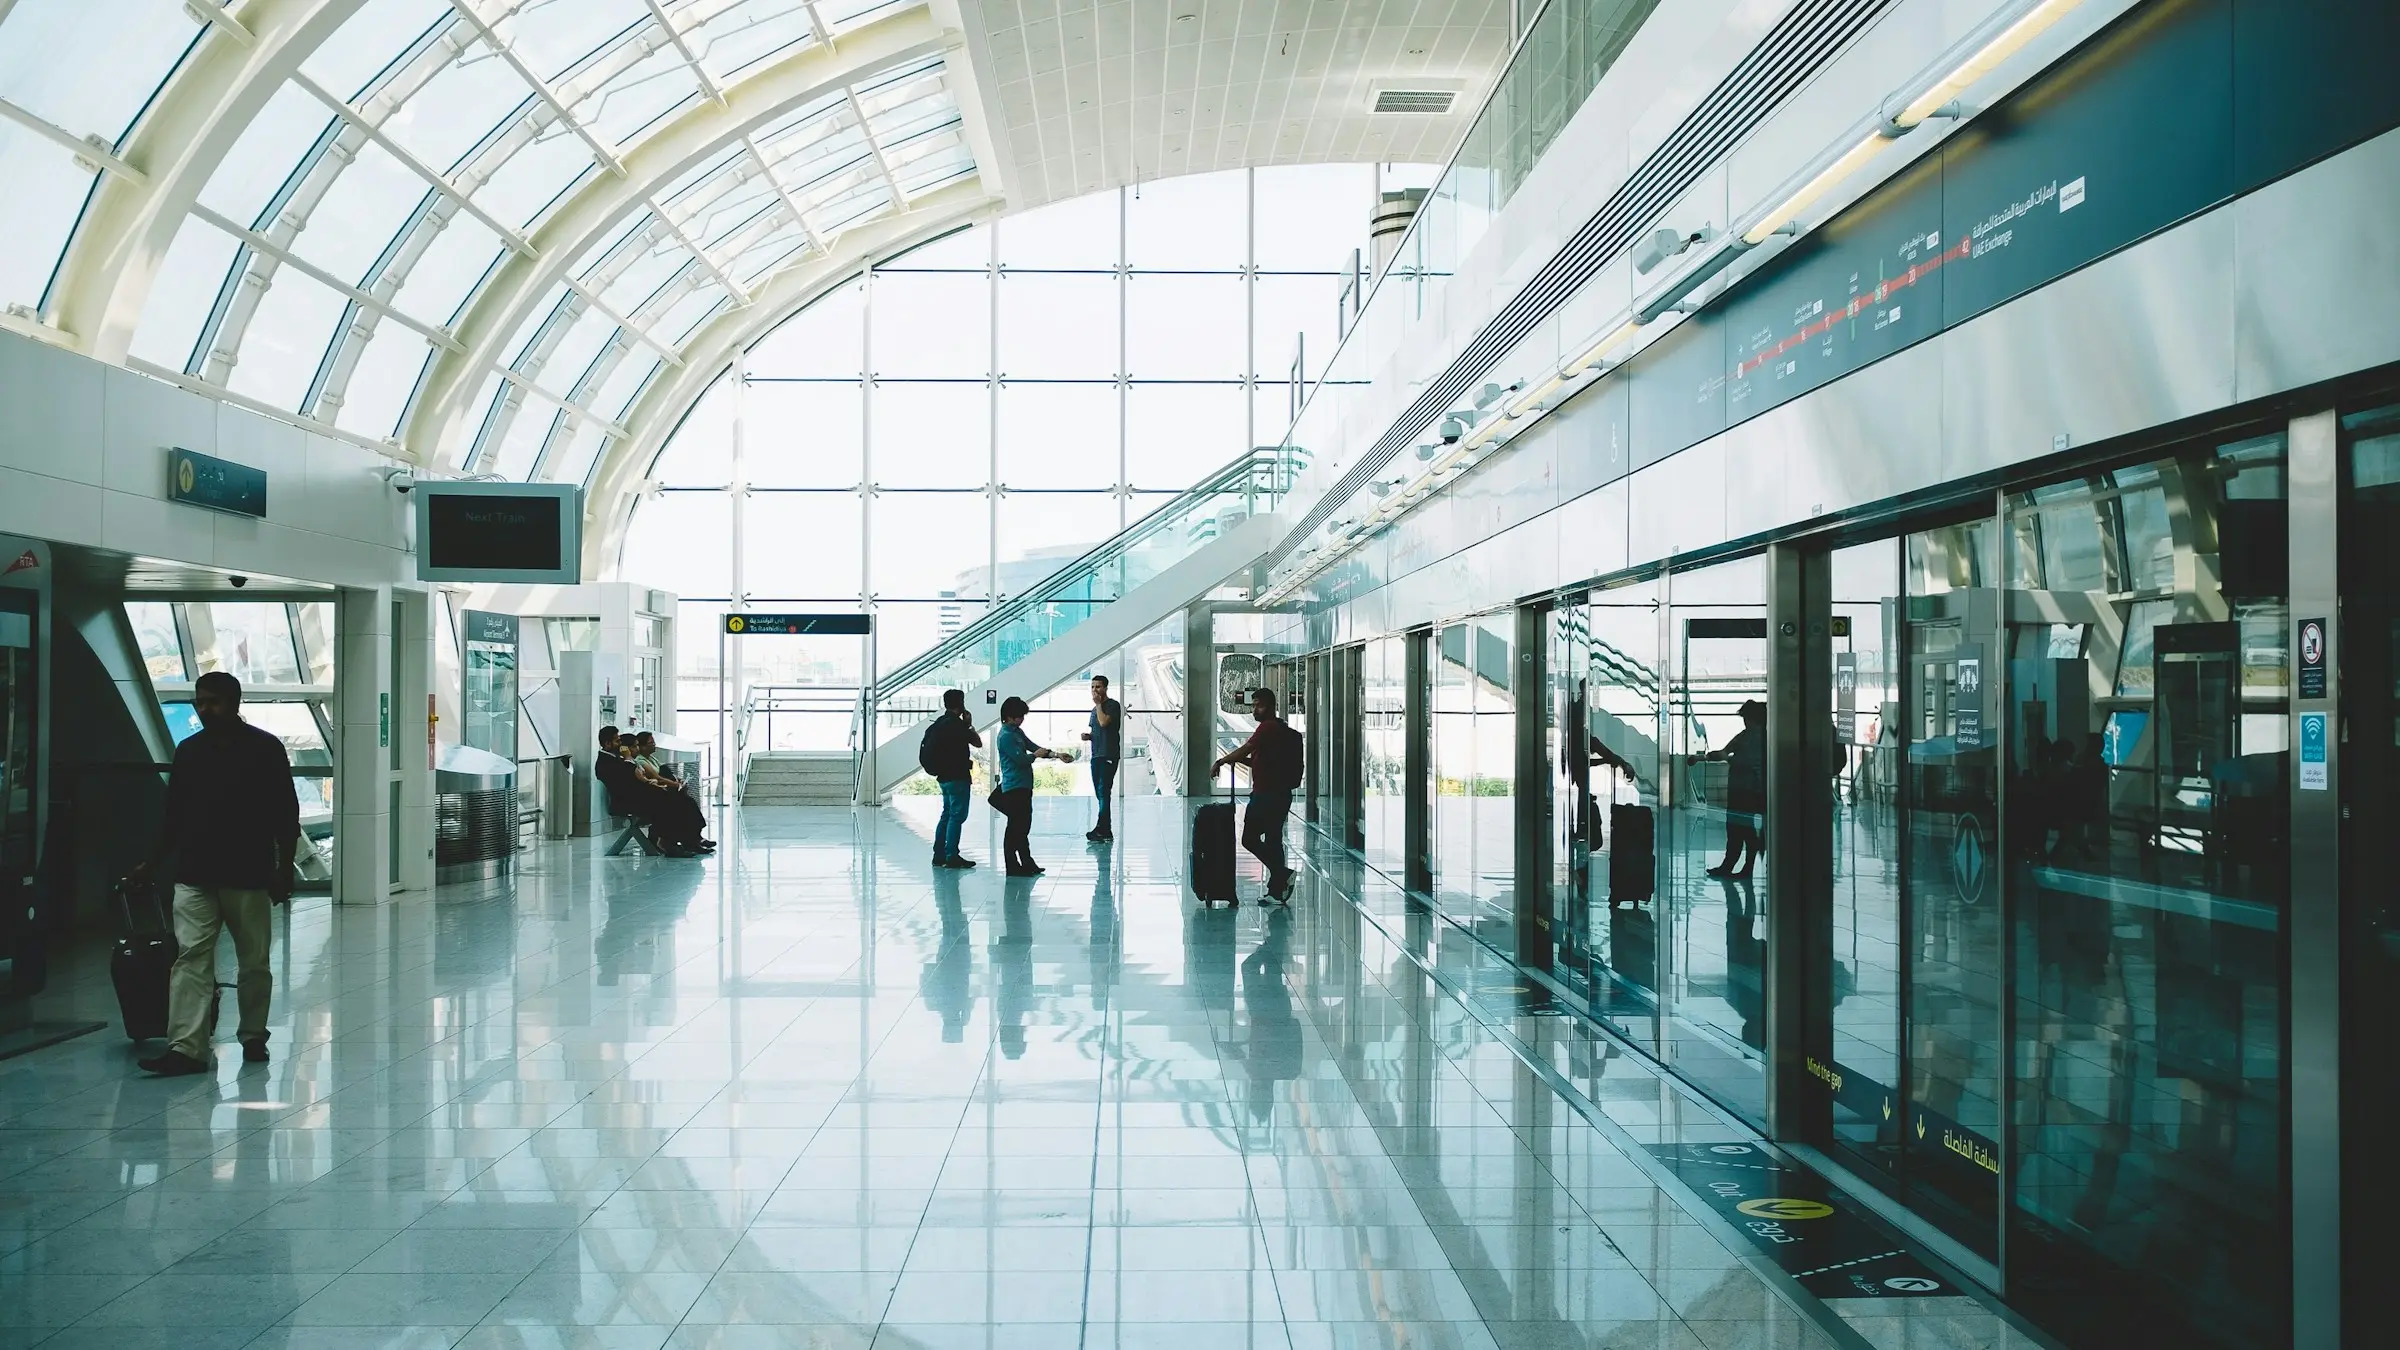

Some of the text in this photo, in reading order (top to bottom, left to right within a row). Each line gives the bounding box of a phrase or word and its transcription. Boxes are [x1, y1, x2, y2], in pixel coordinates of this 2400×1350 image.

[1972, 230, 2013, 259] UAE Exchange
[465, 510, 526, 525] Next Train
[1806, 1056, 1843, 1093] Mind the gap
[1943, 1128, 1974, 1160] الفاصلة
[1708, 1182, 1746, 1198] Out
[1745, 1220, 1804, 1244] خروج
